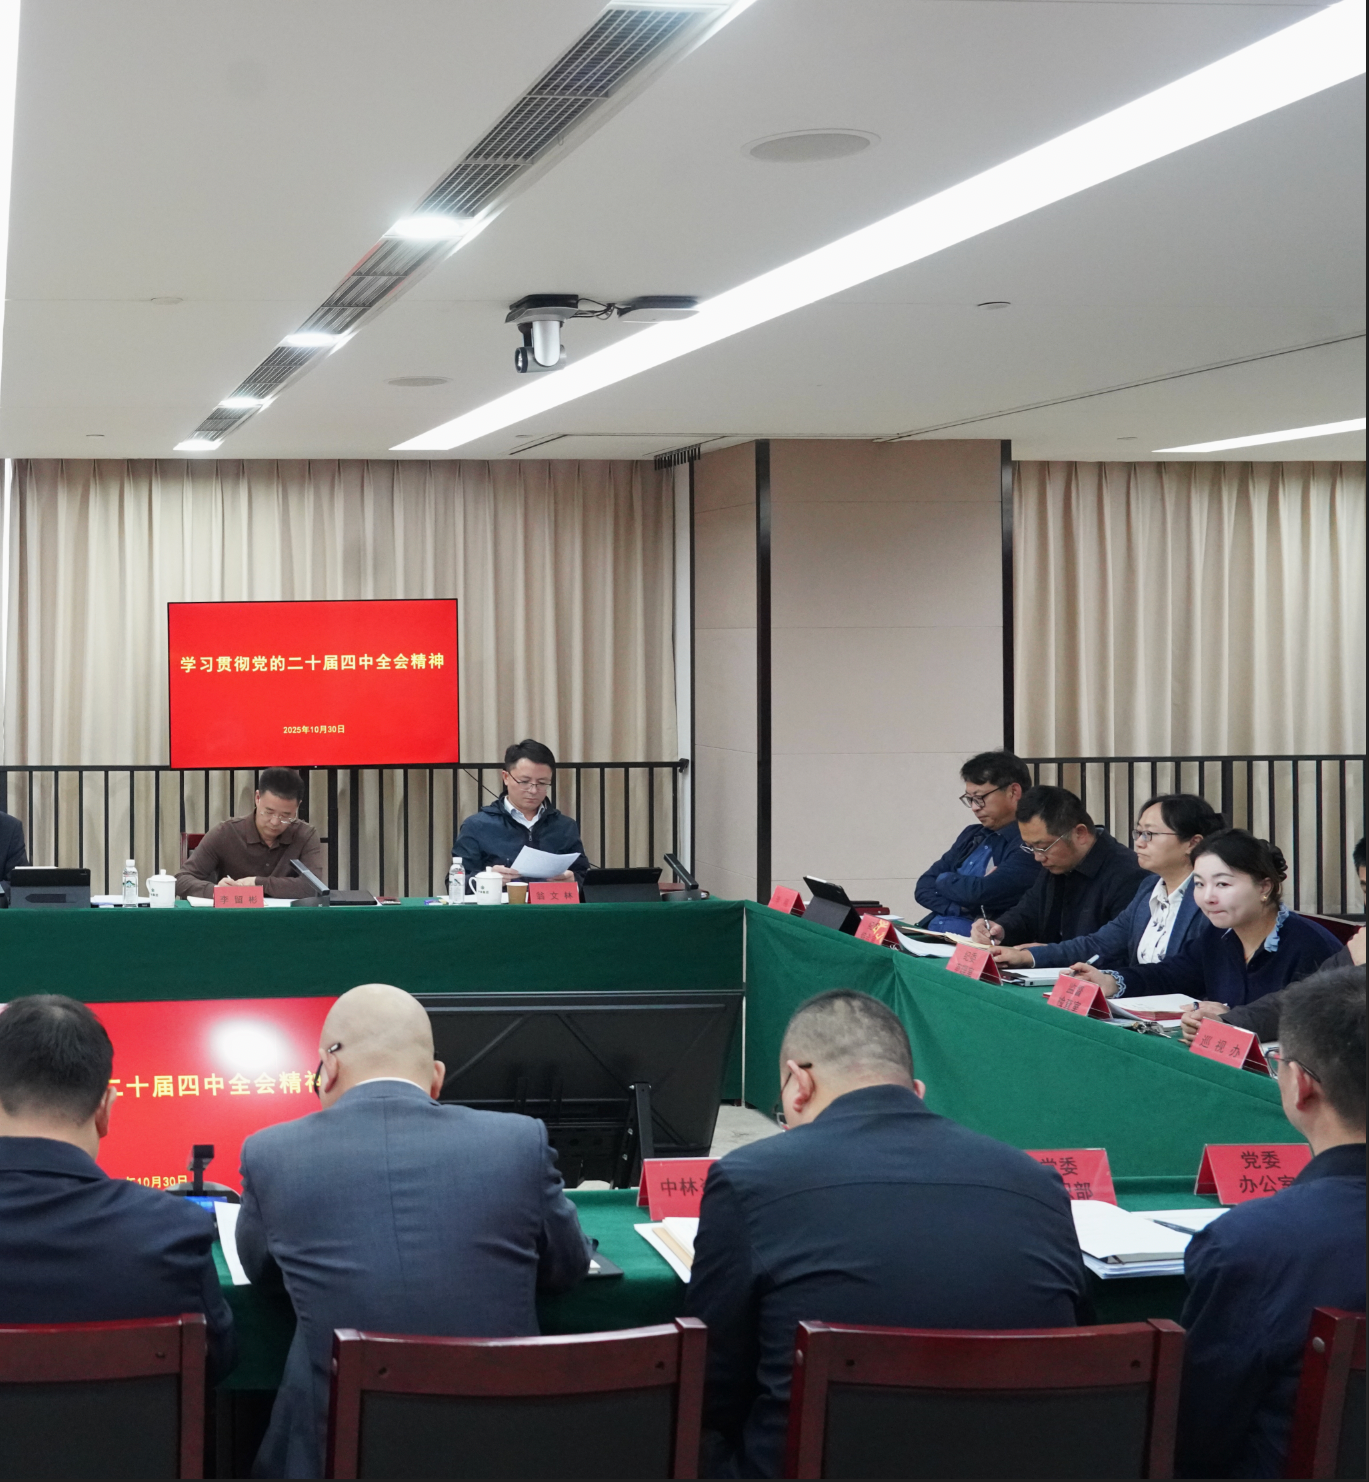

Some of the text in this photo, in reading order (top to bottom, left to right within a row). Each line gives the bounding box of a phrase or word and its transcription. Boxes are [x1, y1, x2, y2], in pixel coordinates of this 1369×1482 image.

[180, 653, 445, 673] 学习贯彻党的二十届四中全会精神
[283, 724, 345, 734] 2025年10月30日
[1199, 1034, 1241, 1058] 巡视办
[1241, 1151, 1281, 1169] 党委
[660, 1177, 706, 1197] 中林
[1239, 1174, 1295, 1193] 办公室
